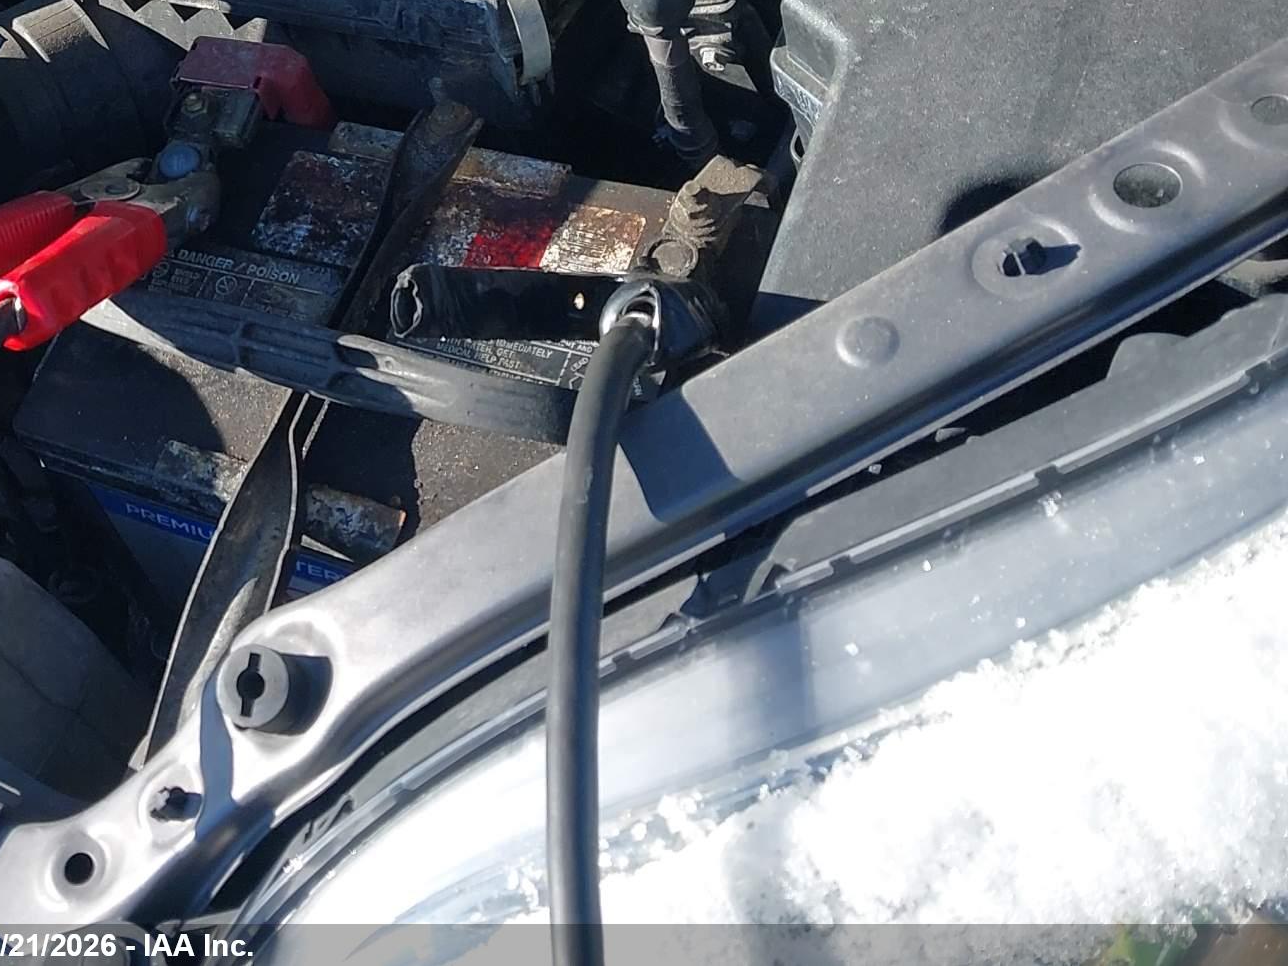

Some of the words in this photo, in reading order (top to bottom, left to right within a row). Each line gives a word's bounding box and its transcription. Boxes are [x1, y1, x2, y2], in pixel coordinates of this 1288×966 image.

[178, 249, 235, 270] DANGER
[246, 262, 300, 285] POISON
[125, 502, 214, 540] PREMIU
